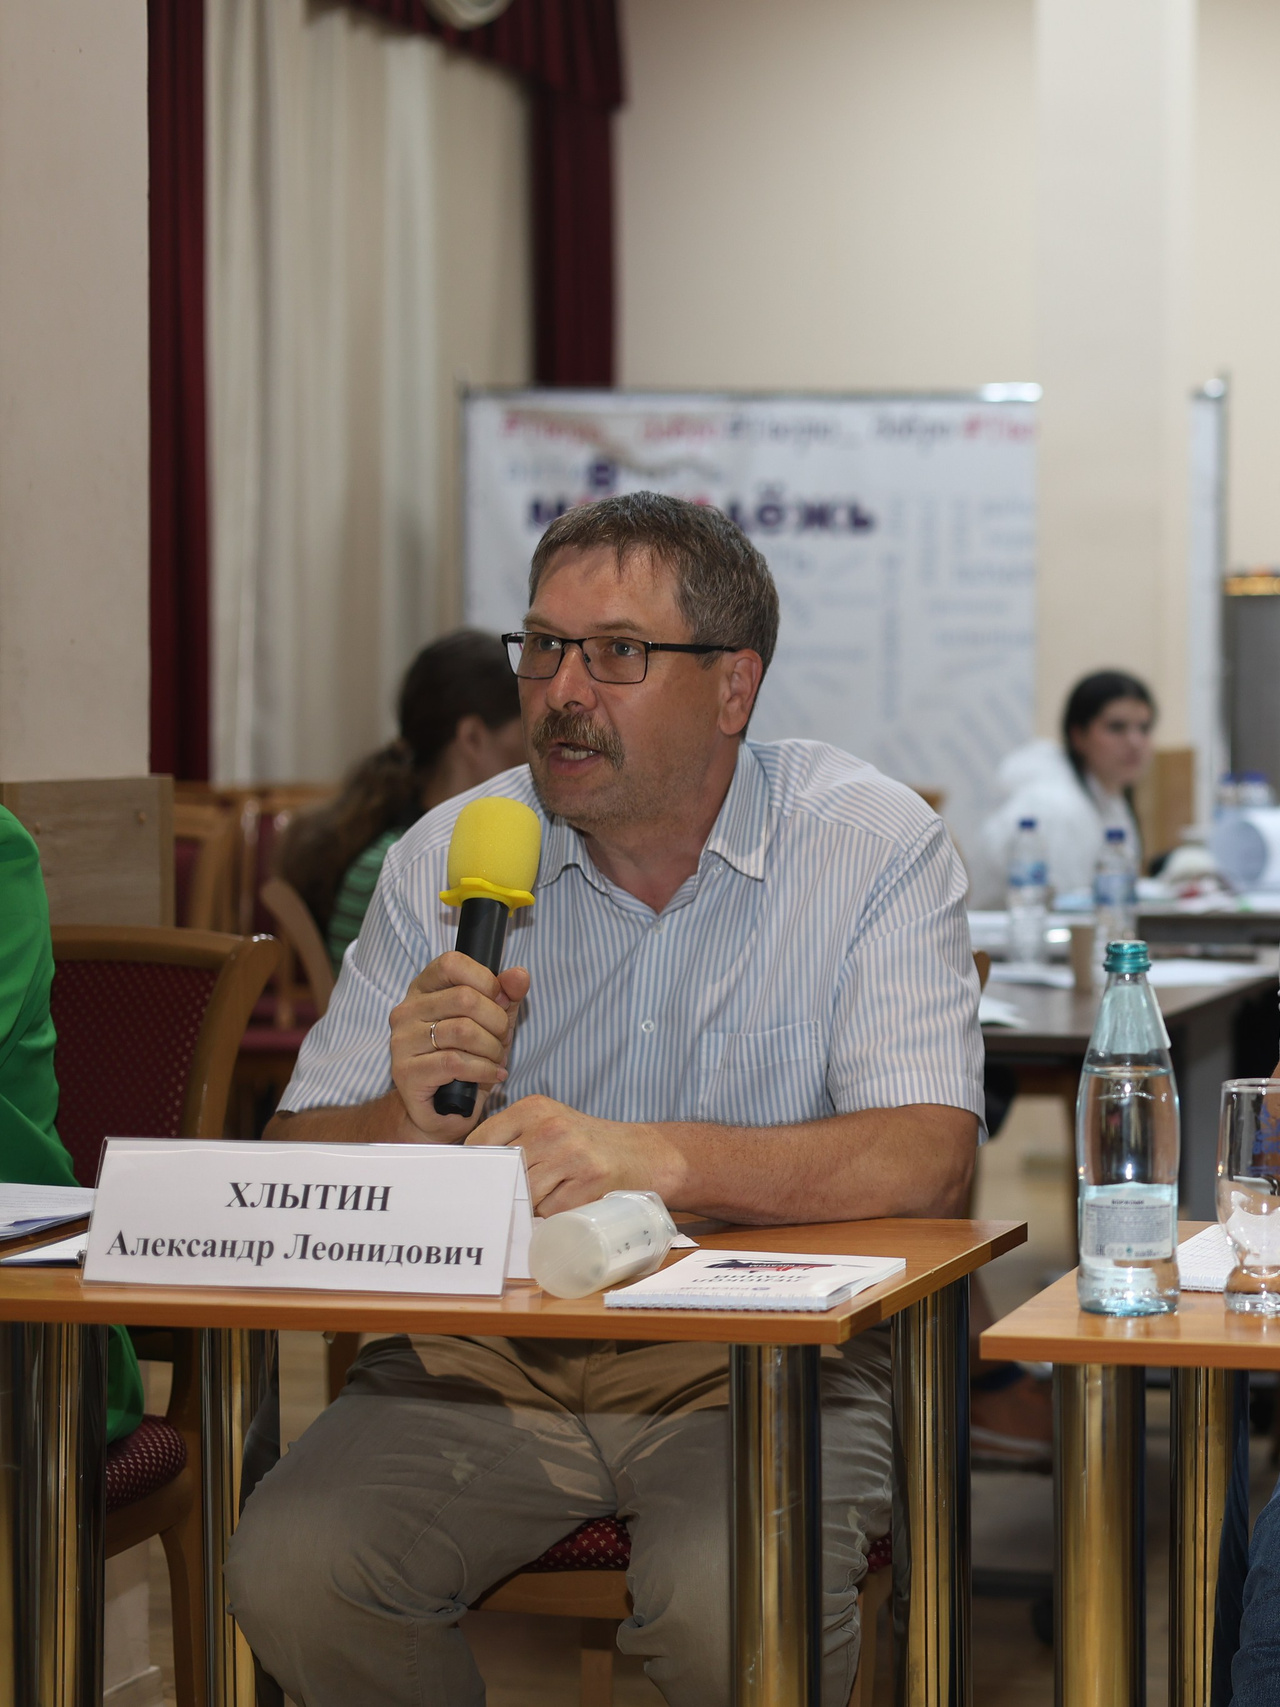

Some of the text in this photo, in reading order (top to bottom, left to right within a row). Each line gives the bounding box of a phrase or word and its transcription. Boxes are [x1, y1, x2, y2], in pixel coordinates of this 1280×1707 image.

[224, 1181, 393, 1212] ХЛЫТИН
[105, 1229, 485, 1267] Александр Леонидович
